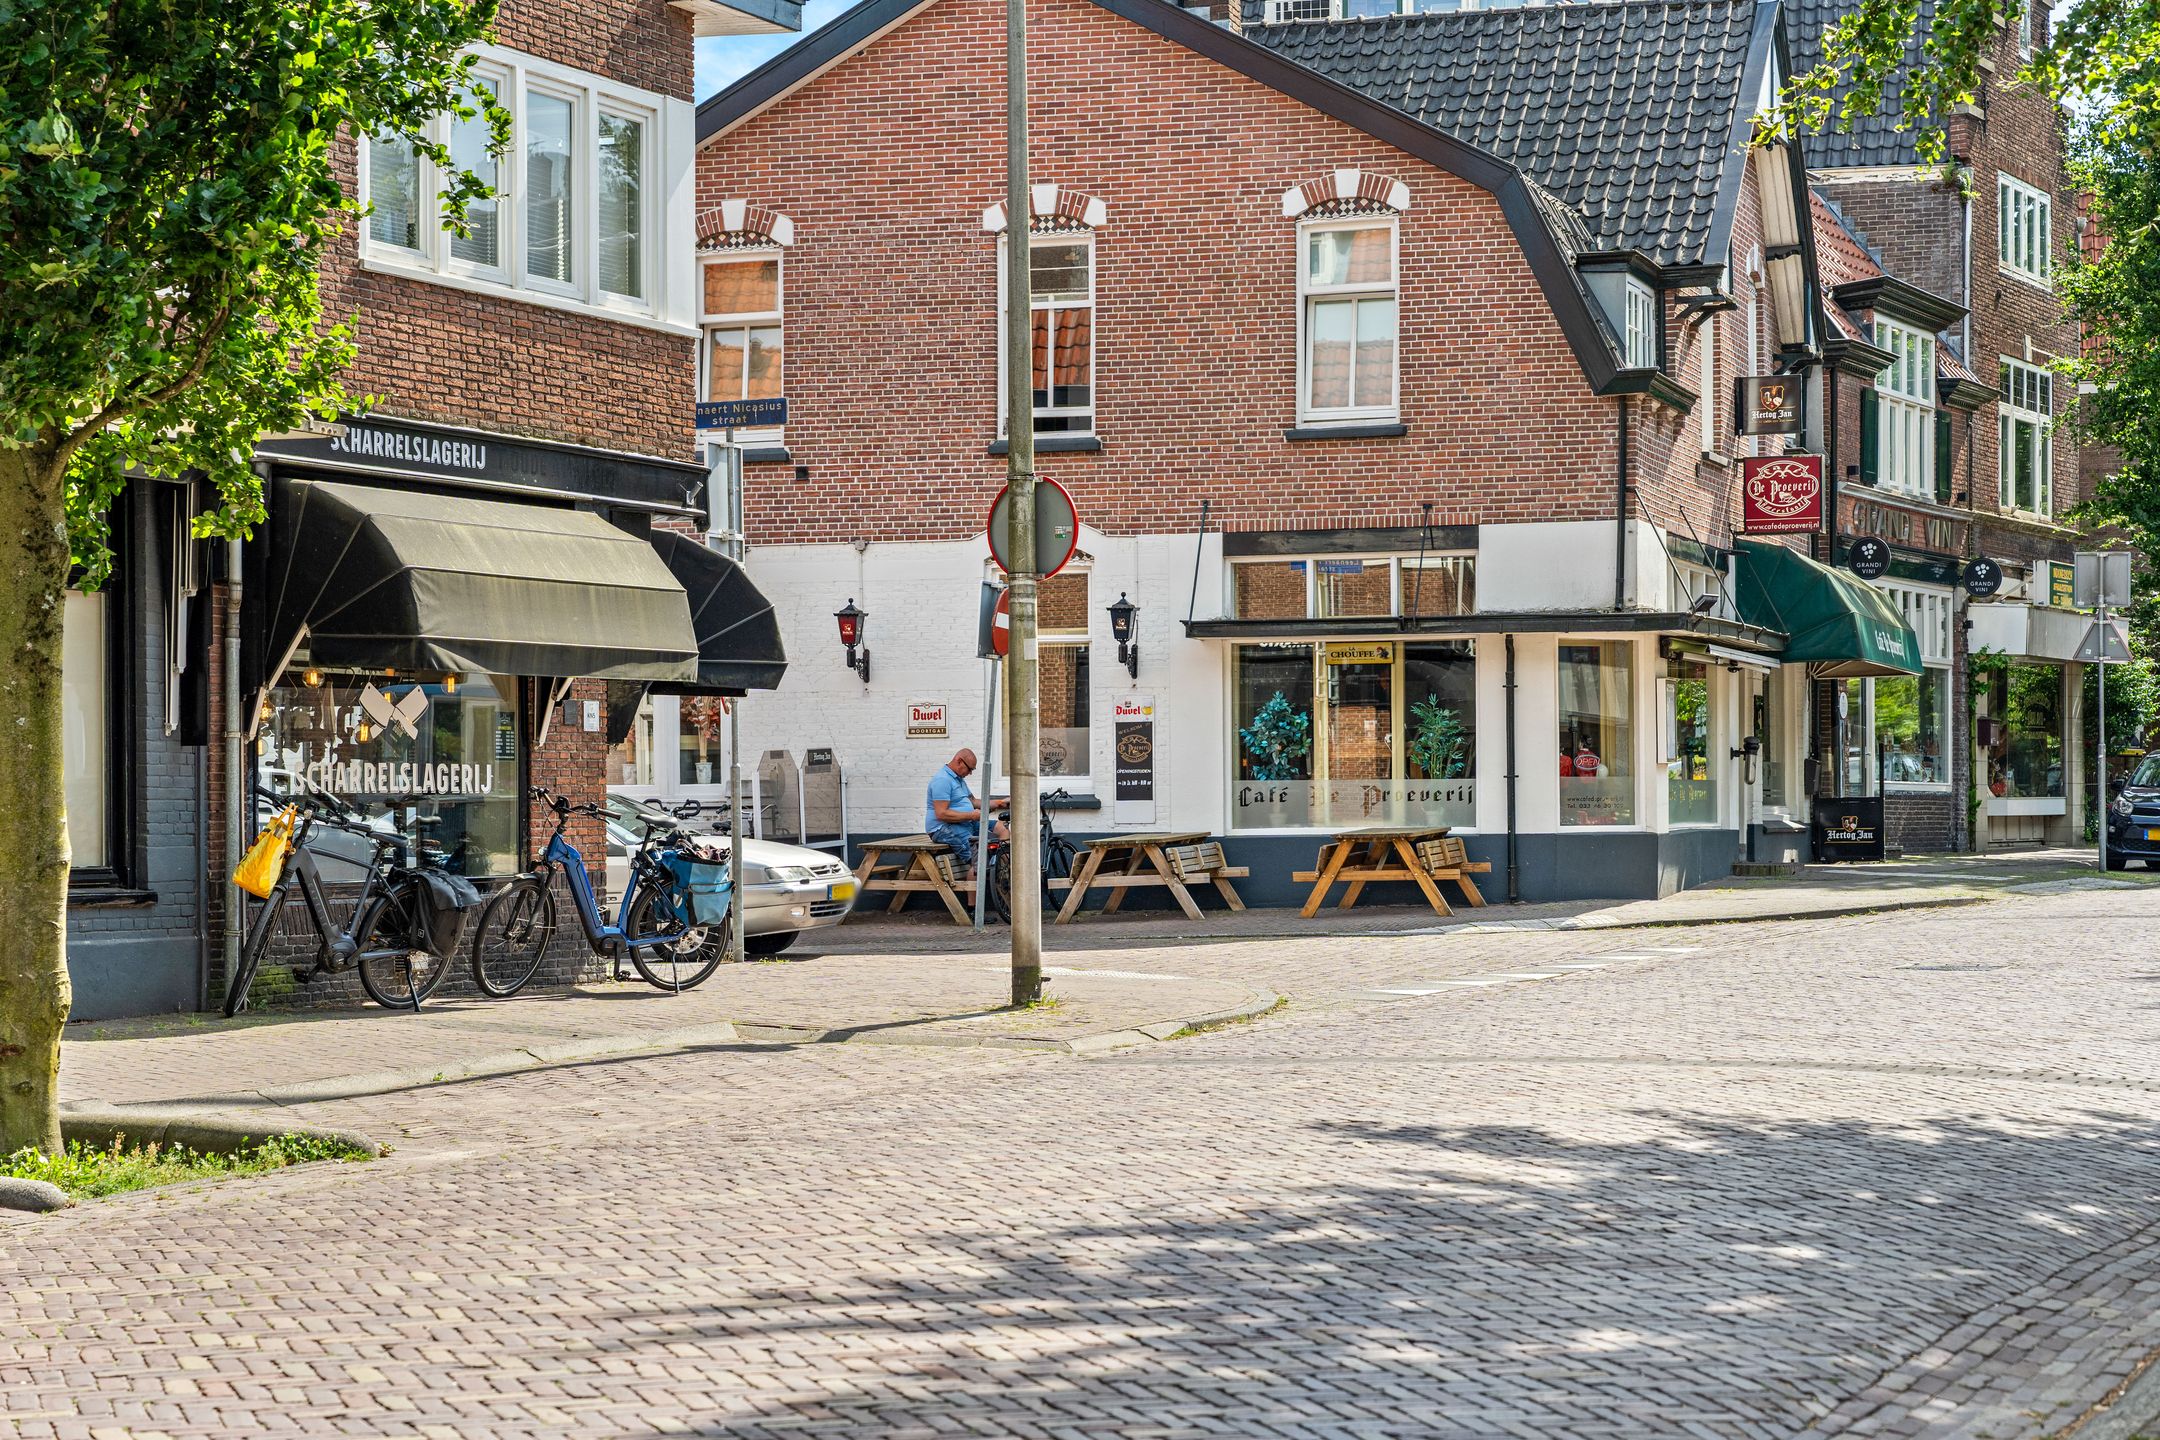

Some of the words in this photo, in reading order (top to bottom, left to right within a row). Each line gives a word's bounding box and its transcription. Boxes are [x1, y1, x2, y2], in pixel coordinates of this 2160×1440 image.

[732, 402, 782, 414] Nicasius
[712, 415, 747, 425] straat
[1751, 410, 1777, 422] Hertog
[1777, 410, 1793, 420] Jan
[330, 426, 487, 470] SCHARRELSLAGERIJ
[1753, 480, 1765, 496] De
[1770, 480, 1815, 503] Proeverij
[1747, 521, 1820, 531] www.cafedeproeverij.nl
[1852, 501, 1914, 543] GRANDI
[1923, 517, 1957, 549] VINI
[1330, 650, 1376, 659] CHOUFFE
[913, 707, 942, 721] Duvel
[1116, 706, 1141, 715] Duvel
[1578, 757, 1600, 767] OPEN
[293, 761, 494, 796] SCHARRELSLAGERIJ
[1237, 785, 1289, 808] Café
[1359, 784, 1474, 817] Proeverij
[1827, 830, 1856, 841] Hertog
[1857, 830, 1873, 841] Jan
